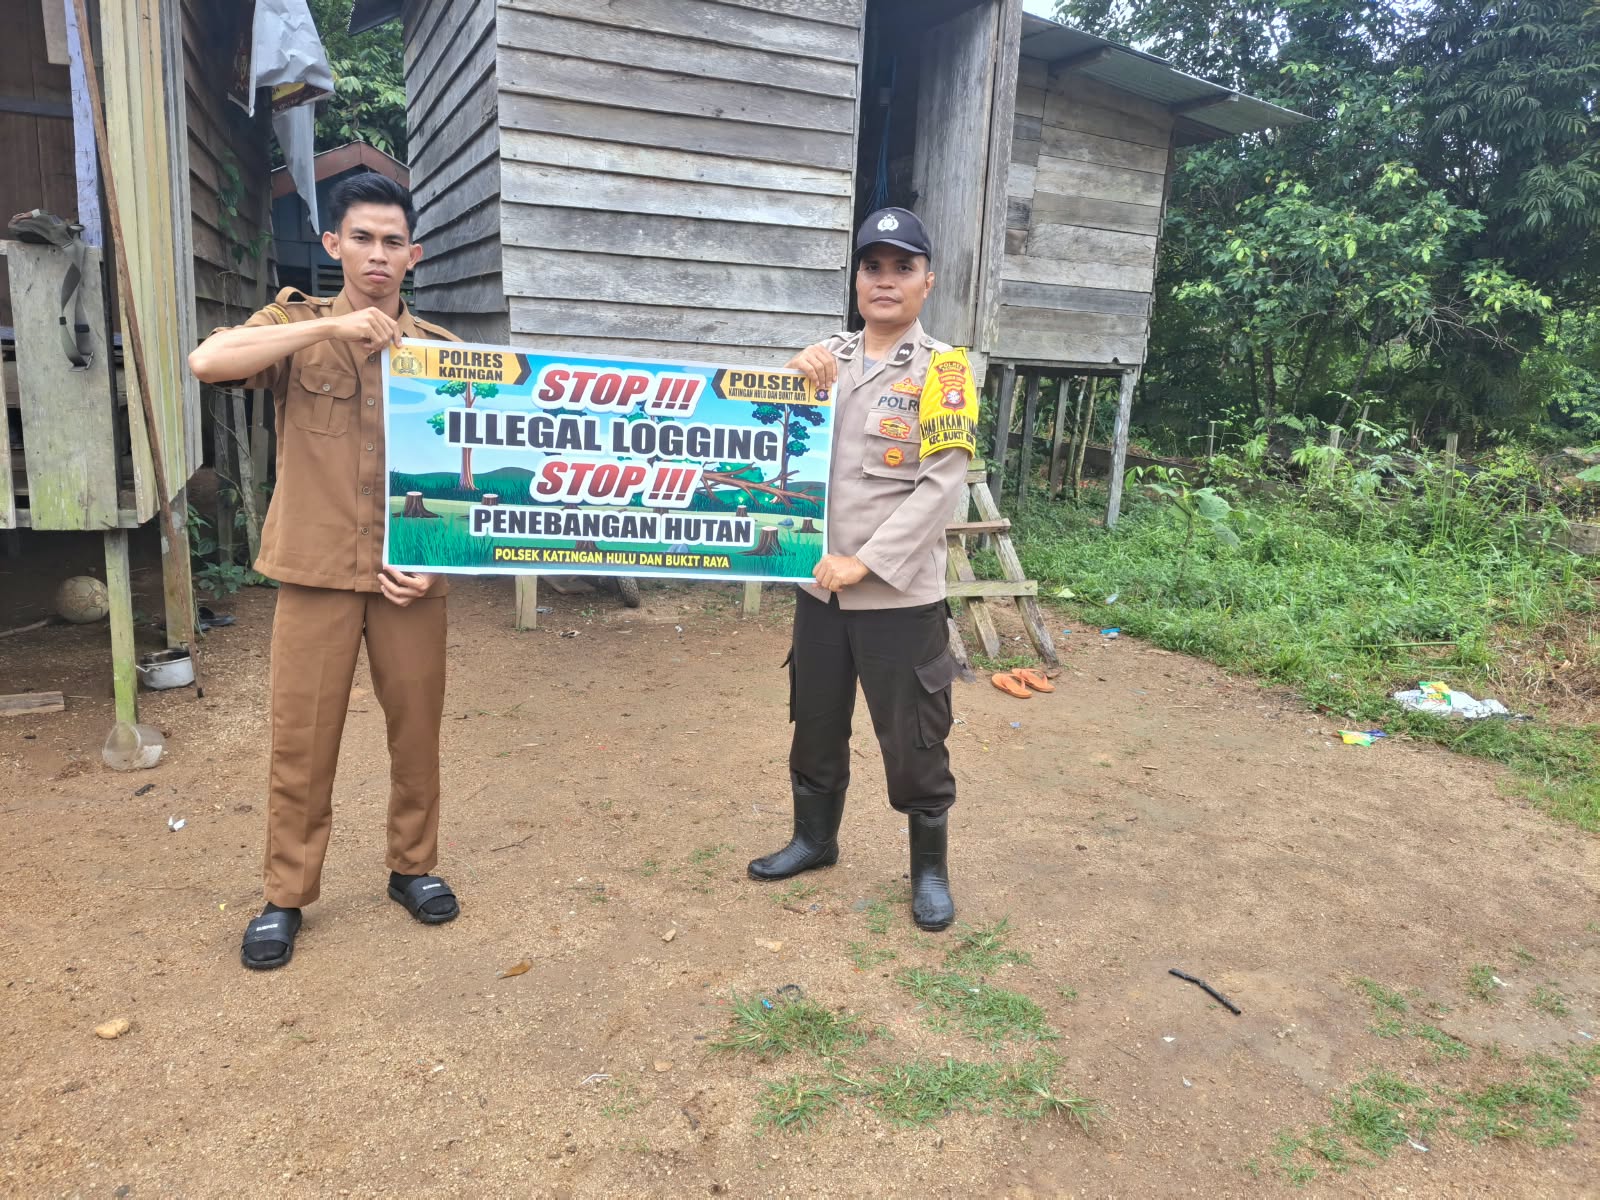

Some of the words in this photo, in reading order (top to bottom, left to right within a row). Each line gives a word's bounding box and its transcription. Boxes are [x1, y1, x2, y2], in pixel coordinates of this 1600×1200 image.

[439, 350, 503, 369] POLRES
[439, 366, 503, 381] KATINGAN
[729, 372, 806, 392] POLSEK
[538, 369, 650, 407] STOP
[651, 377, 700, 410] !!!
[728, 387, 753, 398] KATINGAN
[753, 389, 767, 399] HULU
[767, 390, 778, 400] DAN
[778, 391, 793, 401] BUKIT
[794, 392, 807, 402] RAYA
[448, 411, 602, 452] ILLEGAL
[612, 421, 778, 462] LOGGING
[536, 461, 647, 498] STOP
[648, 467, 697, 501] !!!
[474, 509, 657, 540] PENEBANGAN
[664, 517, 751, 543] HUTAN
[495, 549, 540, 561] POLSEK
[543, 550, 603, 564] KATINGAN
[606, 552, 637, 565] HULU
[639, 553, 663, 566] DAN
[665, 554, 701, 567] BUKIT
[703, 555, 730, 568] RAYA
